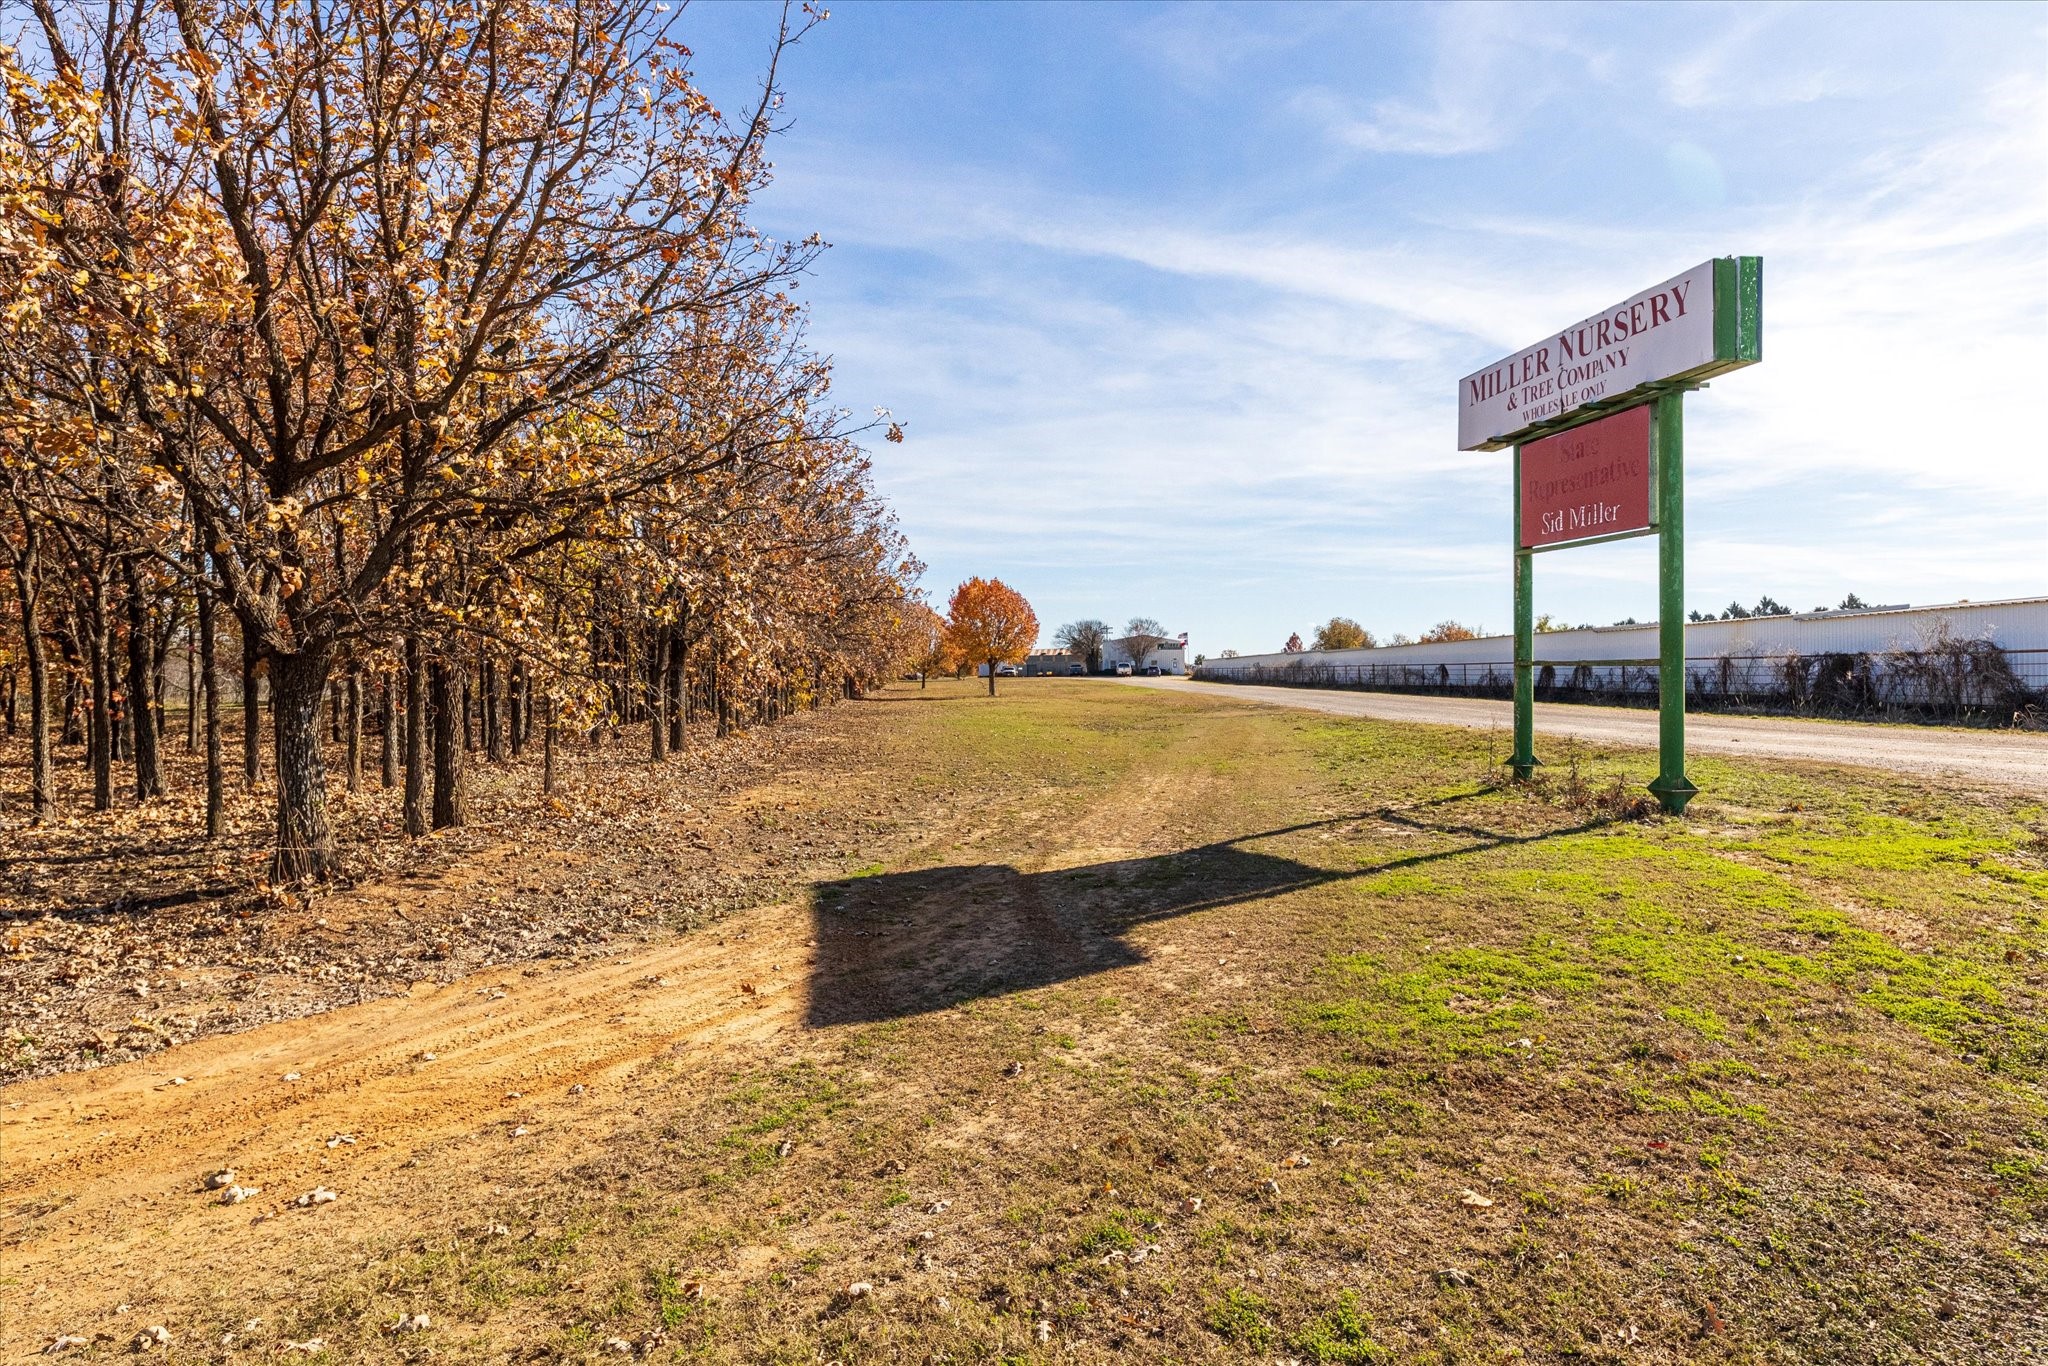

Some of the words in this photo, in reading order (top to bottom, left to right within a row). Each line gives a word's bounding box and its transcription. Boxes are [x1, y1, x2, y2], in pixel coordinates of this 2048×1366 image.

[1469, 347, 1549, 407] MILLER
[1558, 280, 1691, 367] NURSERY
[1507, 391, 1518, 412] &
[1521, 377, 1554, 405] TREE
[1557, 347, 1630, 390] COMPANY
[1522, 389, 1579, 422] WHOLESALE
[1581, 379, 1608, 401] ONLY
[1560, 436, 1600, 463] State
[1529, 456, 1640, 504] Representative
[1541, 510, 1563, 535] Sid
[1569, 502, 1620, 530] Miller
